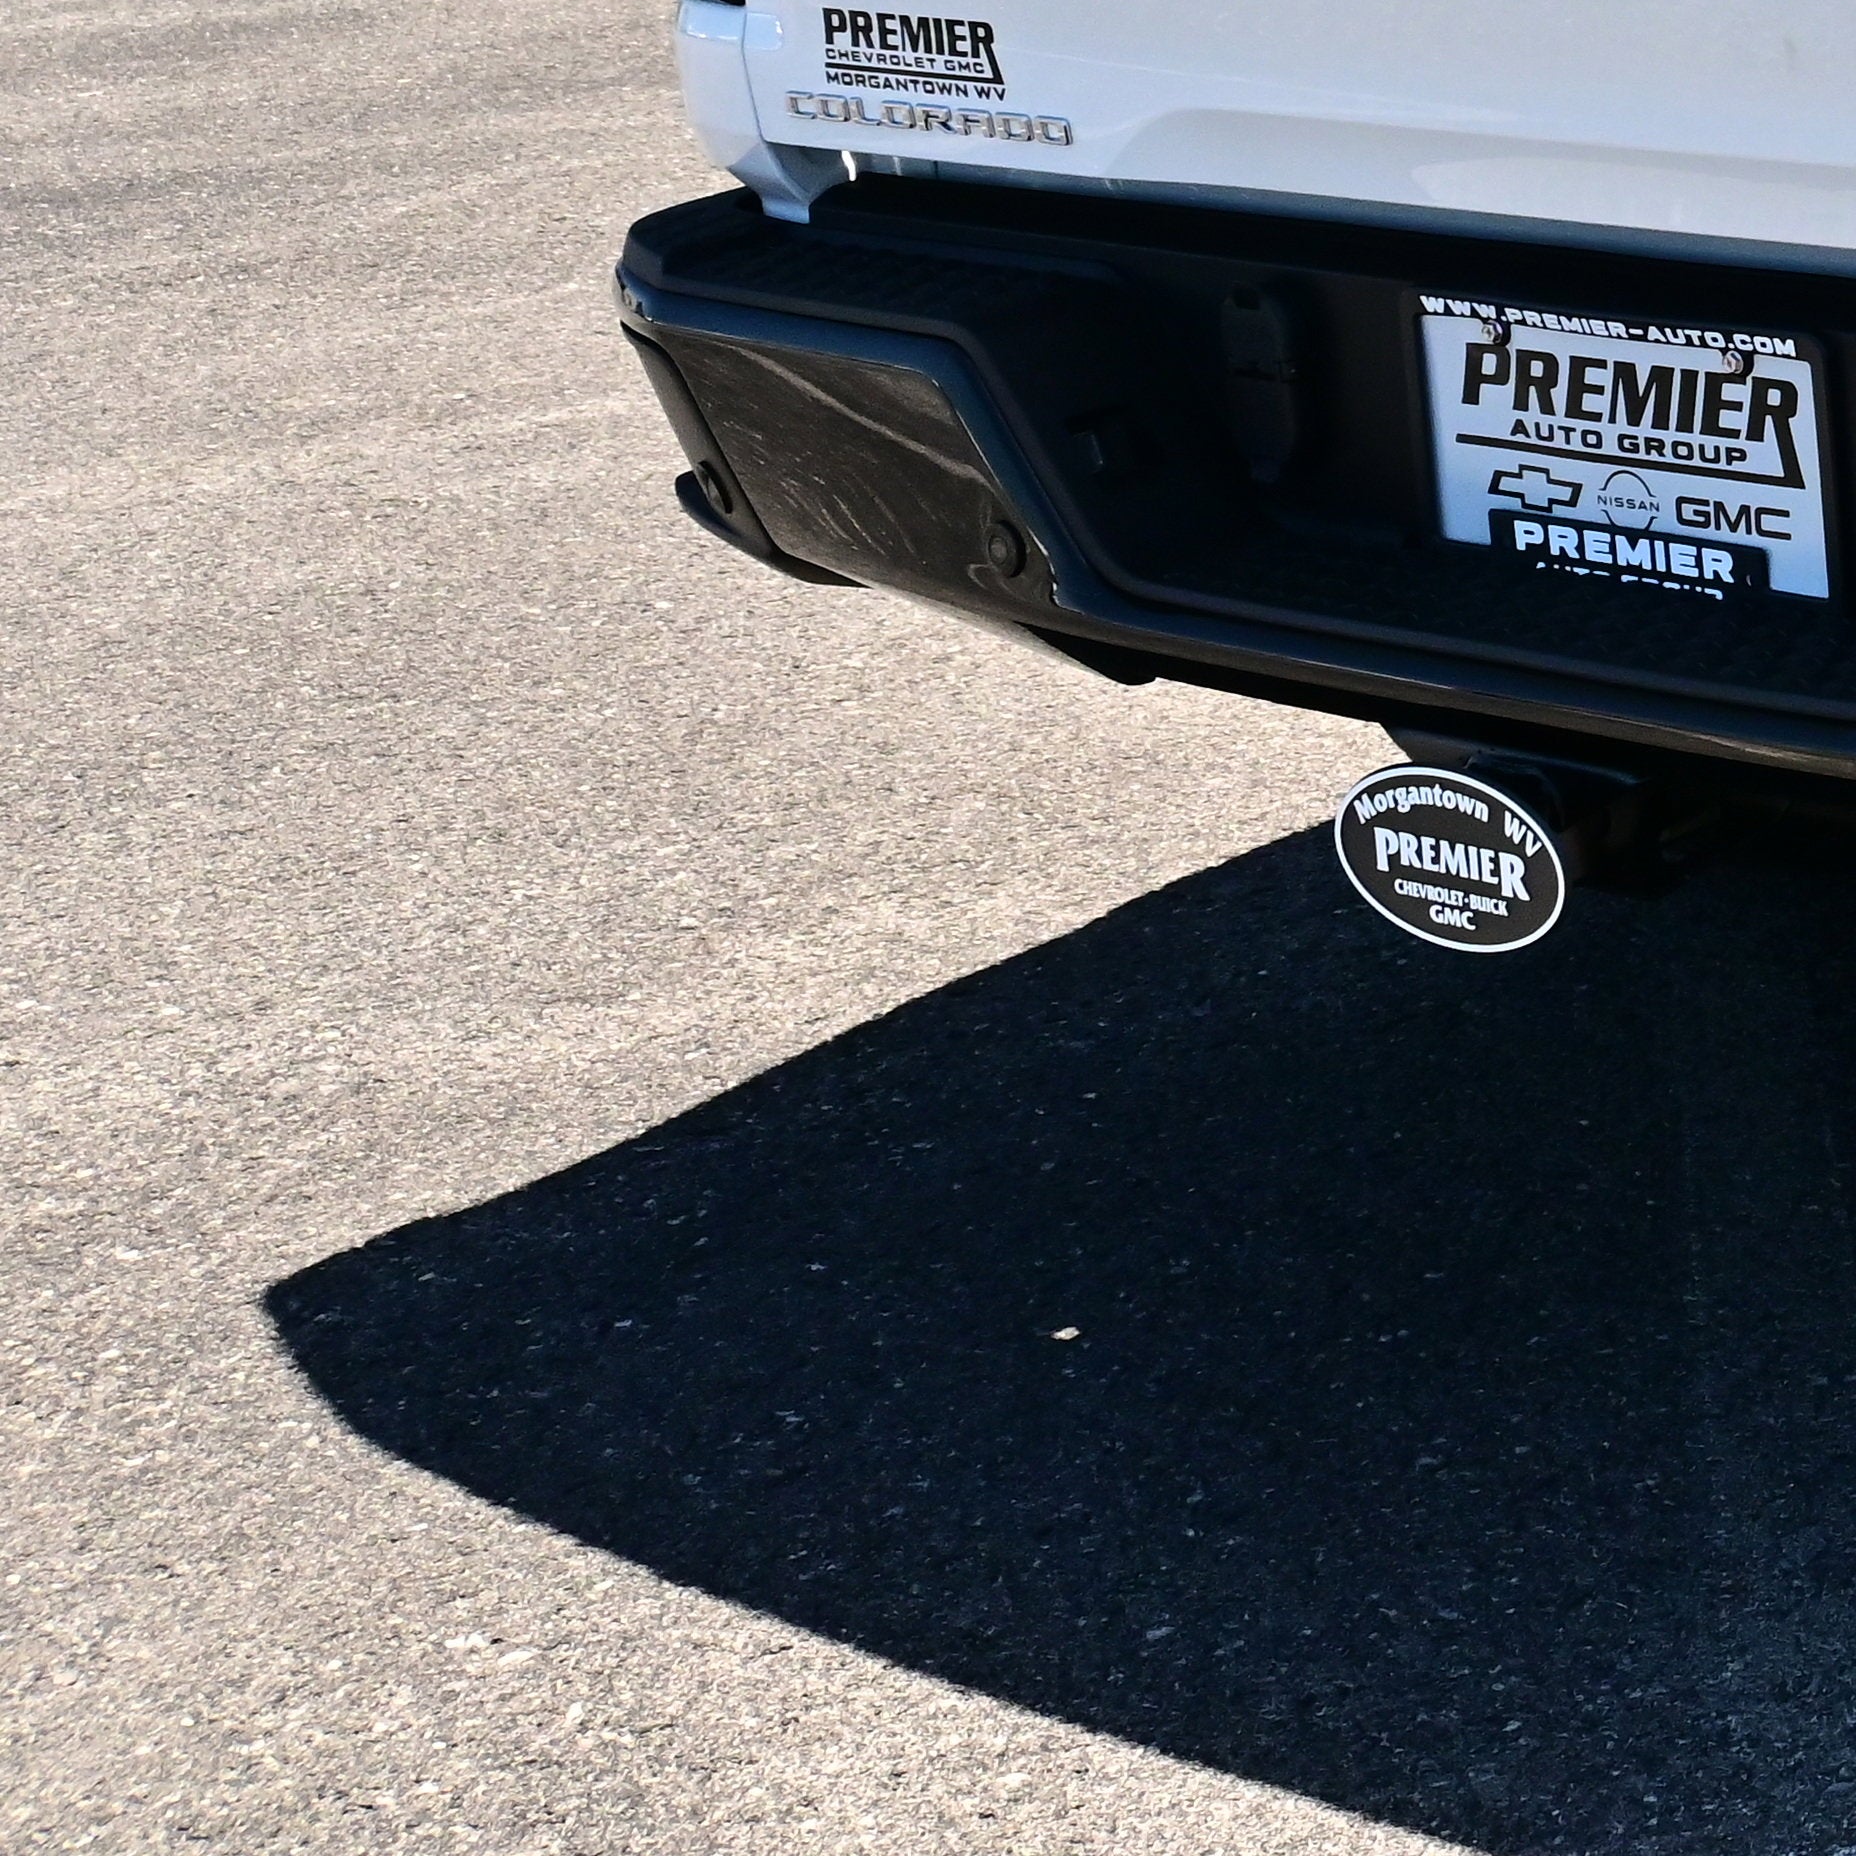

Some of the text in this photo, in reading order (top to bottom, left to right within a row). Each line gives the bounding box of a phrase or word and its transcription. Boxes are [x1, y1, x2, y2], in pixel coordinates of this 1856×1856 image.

[822, 7, 998, 66] PREMIER
[826, 49, 985, 74] CHEVROLET GMC
[826, 71, 1006, 101] MORGANTOWN WV
[785, 90, 1073, 146] COLORADO
[1420, 295, 1795, 357] WWW.PREMIER-AUTO.COM
[1462, 342, 1802, 449] PREMIER
[1510, 420, 1747, 466] AUTO GROUP
[1597, 495, 1660, 513] NISSAN
[1676, 496, 1792, 540] GMC
[1514, 520, 1735, 583] PREMIER
[1354, 783, 1543, 858] Morgantown WV
[1374, 827, 1530, 901] PREMIER
[1429, 905, 1476, 931] GMC
